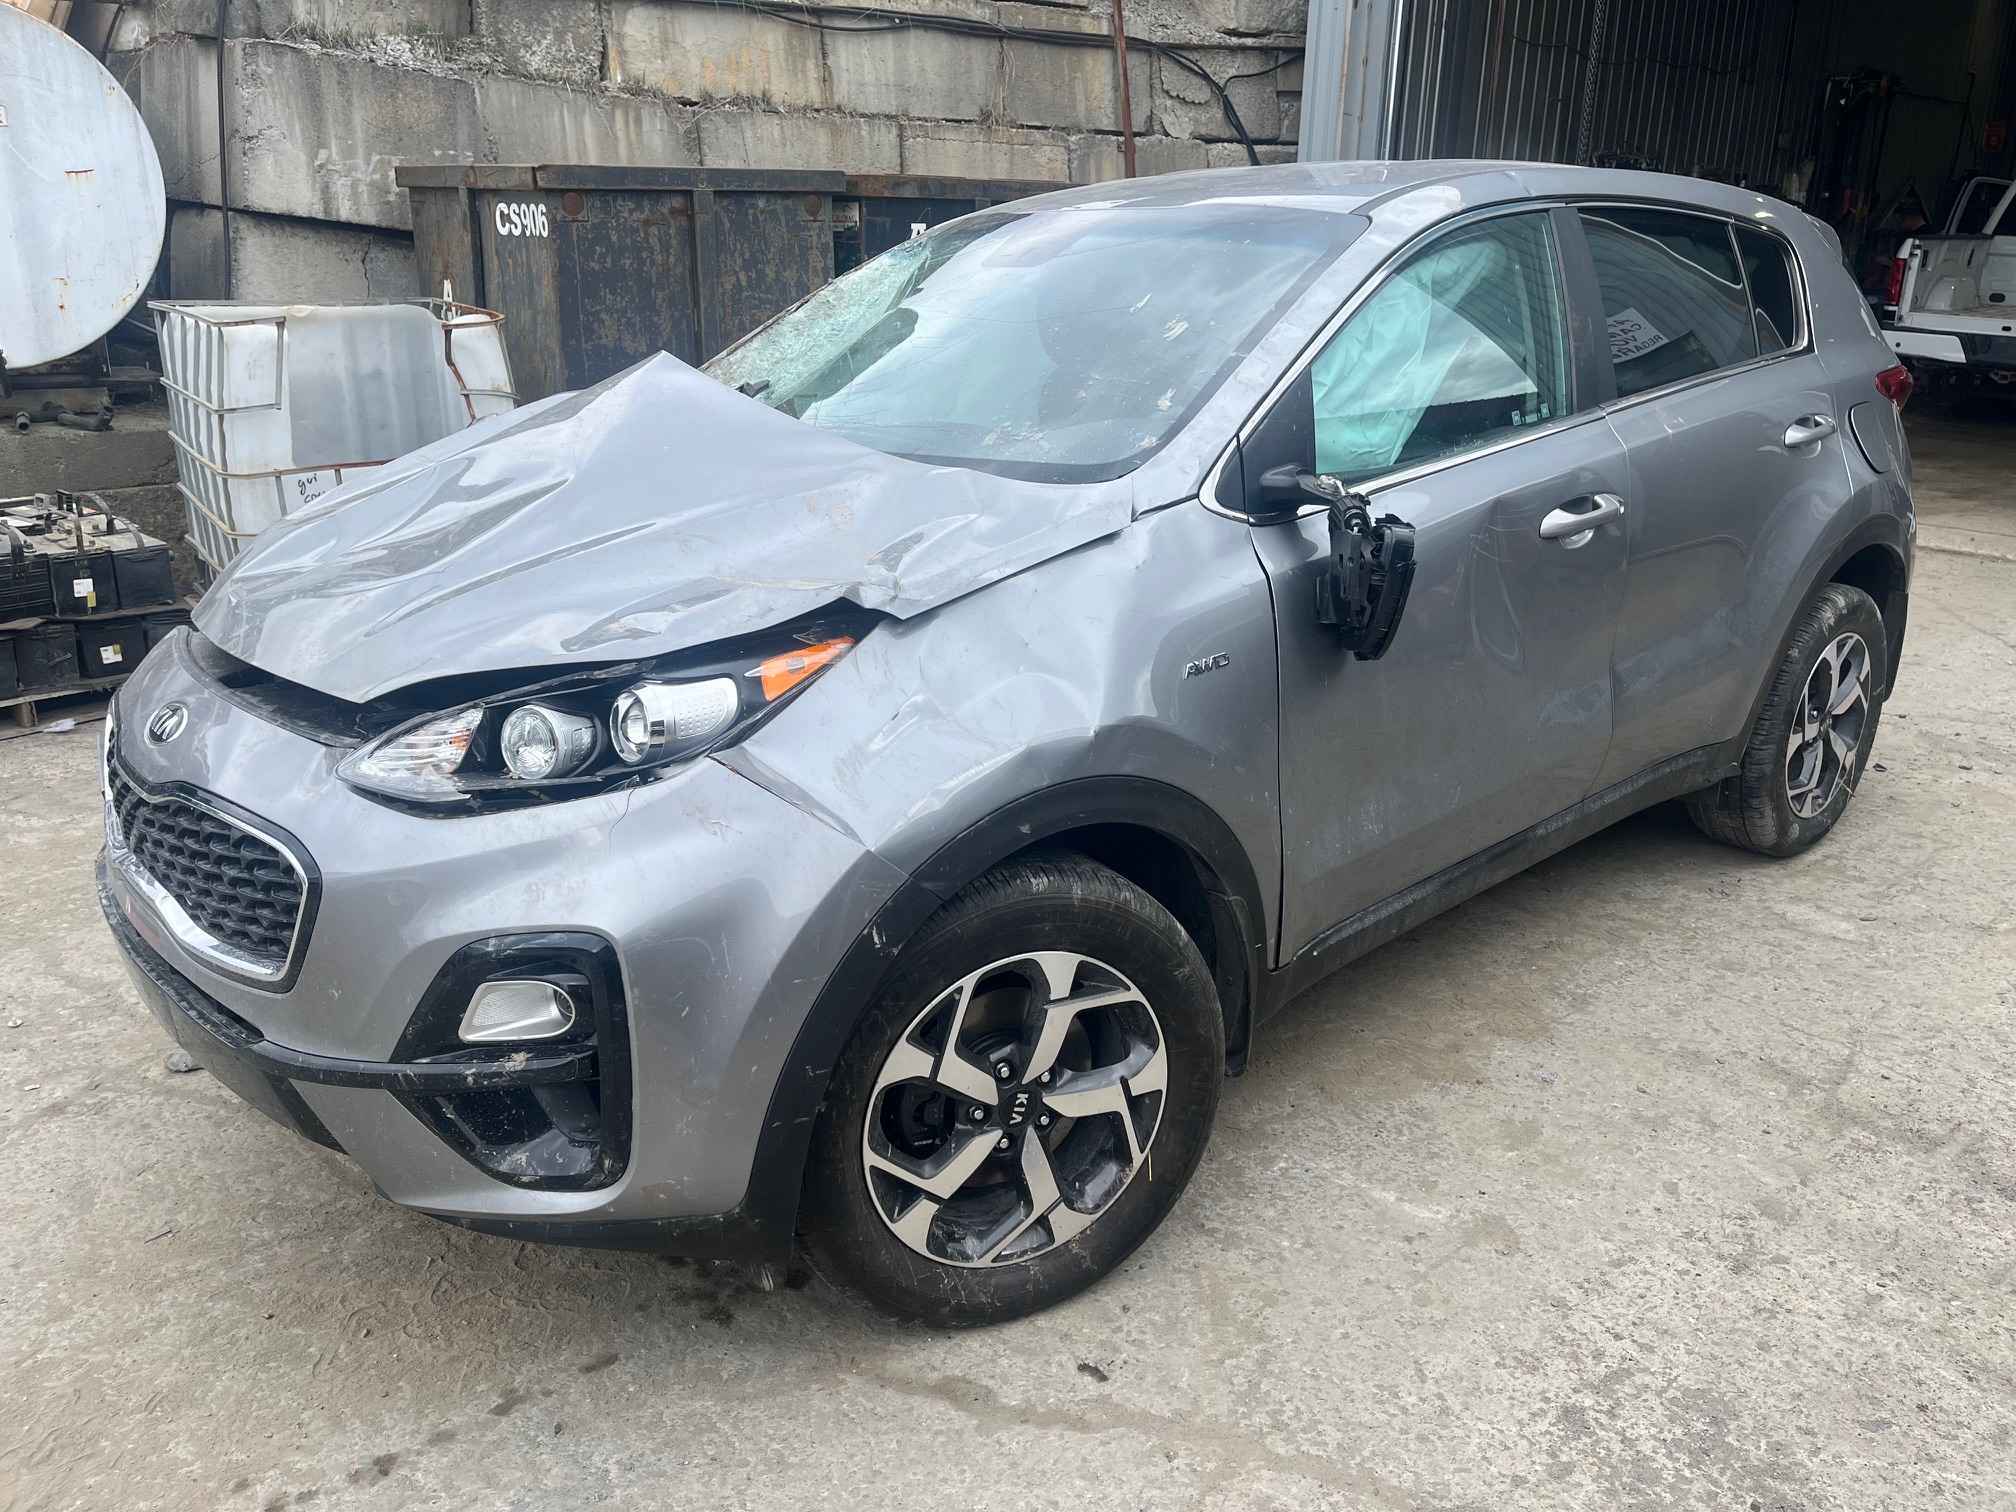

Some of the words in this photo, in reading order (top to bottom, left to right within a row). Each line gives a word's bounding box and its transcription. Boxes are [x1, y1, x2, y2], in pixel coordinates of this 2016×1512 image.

[495, 202, 549, 238] CS906
[1183, 652, 1230, 680] AWD
[1009, 1093, 1029, 1125] KIA
